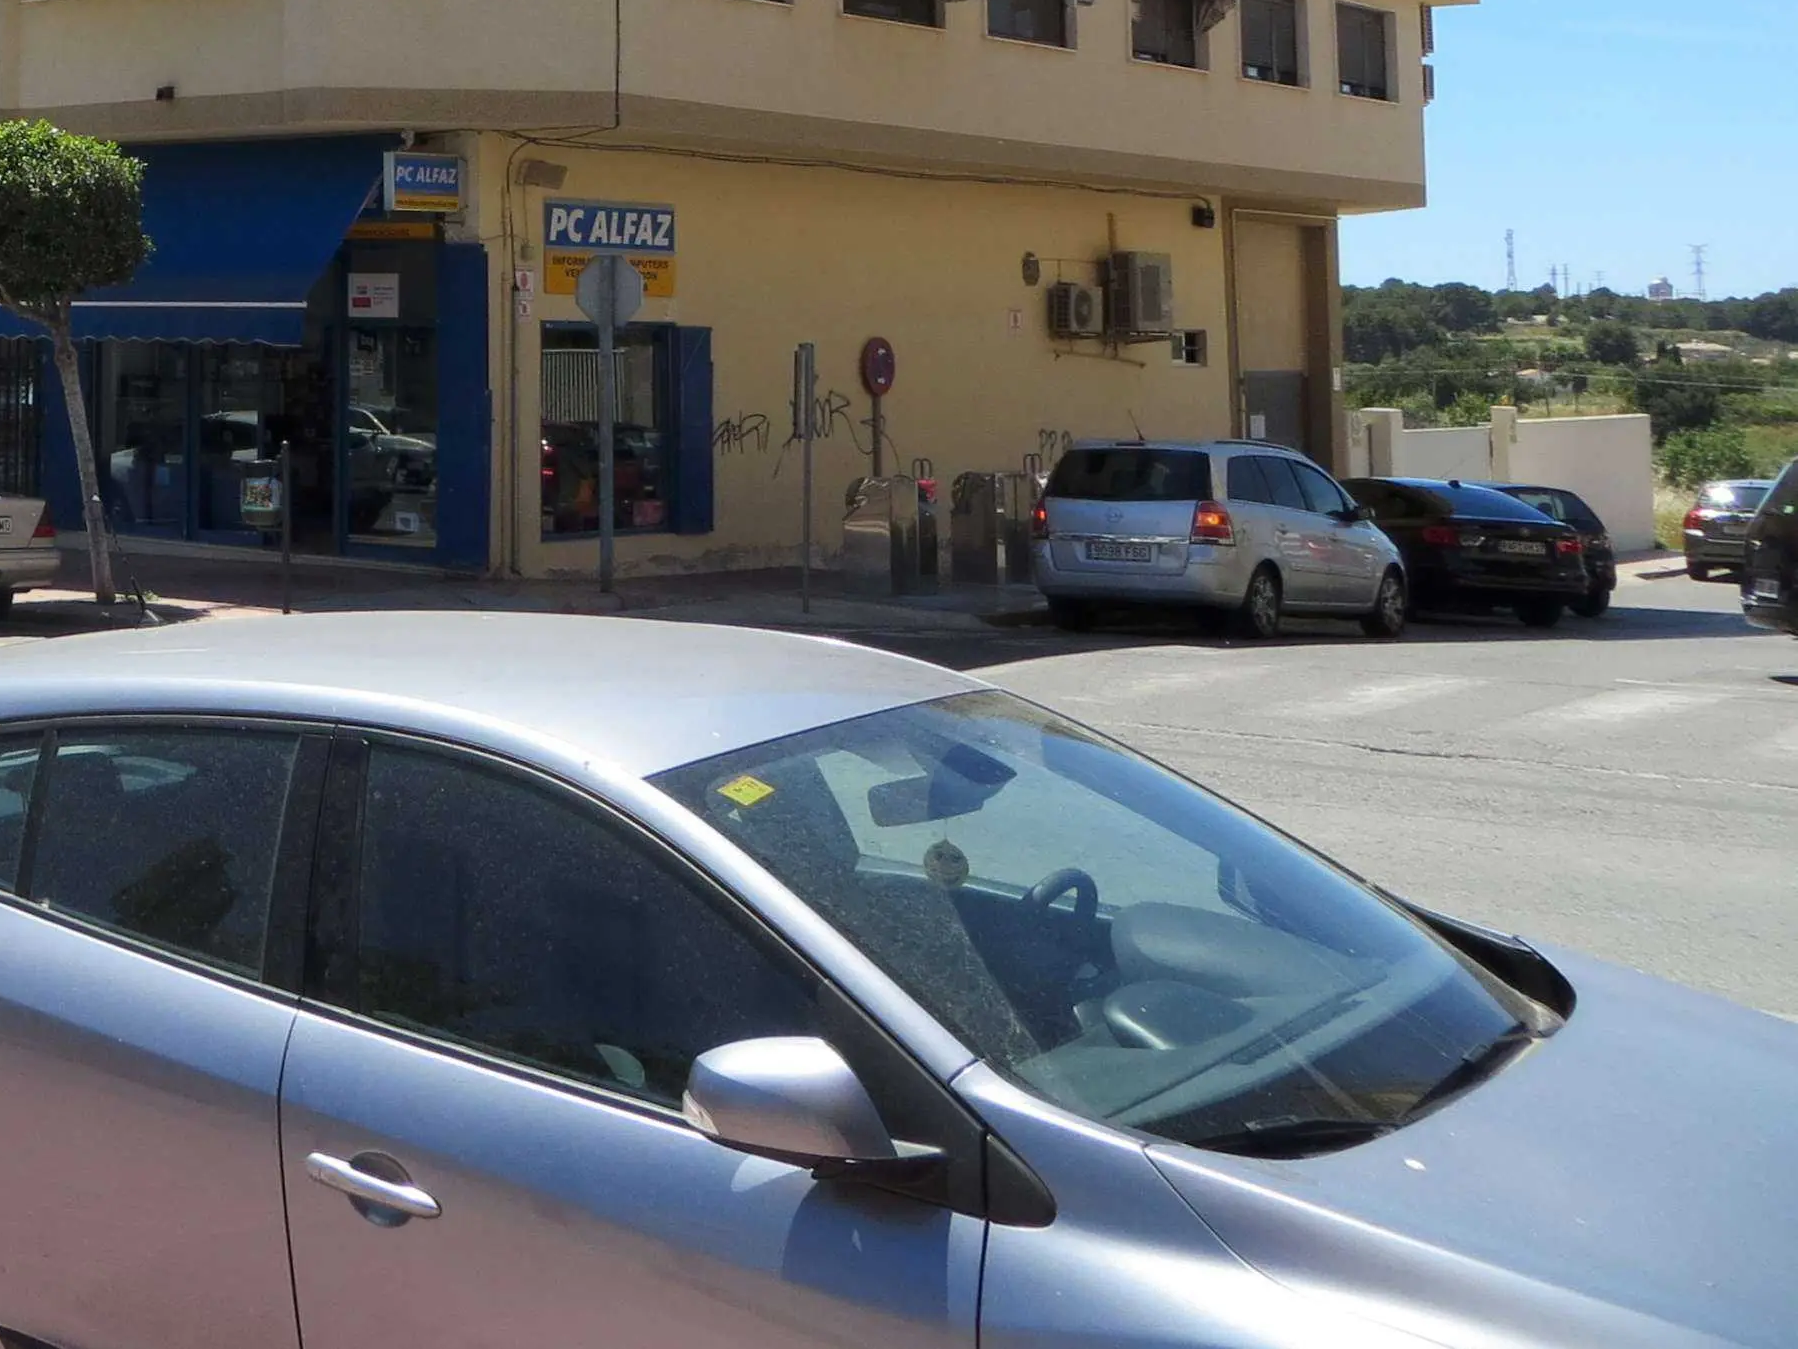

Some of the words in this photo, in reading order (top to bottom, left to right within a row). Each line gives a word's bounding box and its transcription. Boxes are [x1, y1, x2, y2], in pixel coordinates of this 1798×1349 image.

[395, 165, 414, 183] PC
[415, 167, 458, 185] ALFAZ
[549, 208, 585, 243] PC
[589, 210, 673, 246] ALFAZ
